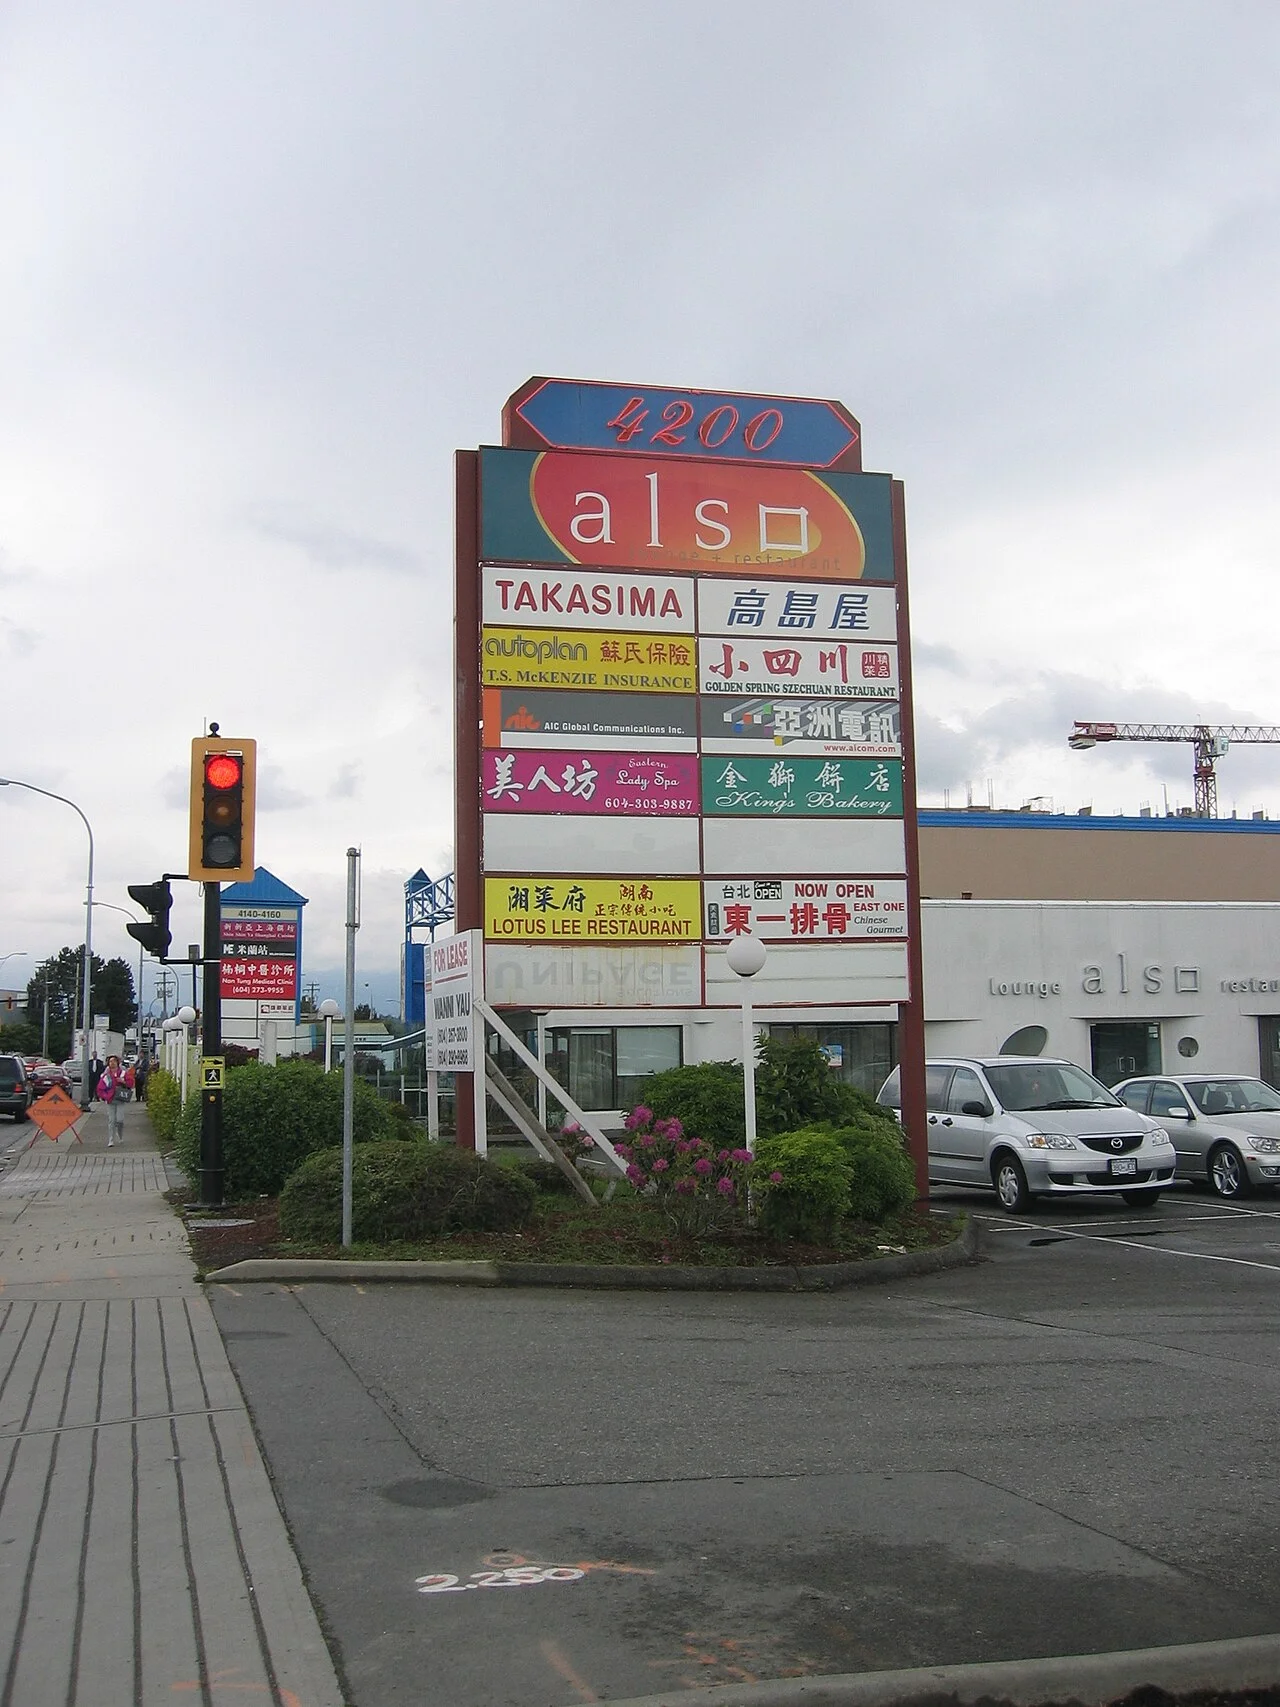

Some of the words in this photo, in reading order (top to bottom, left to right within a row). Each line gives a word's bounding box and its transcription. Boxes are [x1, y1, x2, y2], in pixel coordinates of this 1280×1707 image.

[607, 398, 784, 451] 4200
[495, 580, 683, 619] TAKASIMA
[726, 588, 871, 631] 高島屋
[485, 635, 589, 665] autoplan
[600, 640, 692, 667] 蘇氏保險
[708, 643, 849, 684] 小四川
[486, 669, 512, 682] T.S.
[516, 671, 598, 685] McKENZIE
[604, 674, 693, 689] INSURANCE
[705, 682, 743, 693] GOLDEN
[745, 683, 782, 694] SPRING
[783, 684, 833, 695] SZECHUAN
[834, 686, 897, 698] RESTAURANT
[544, 721, 559, 731] AIC
[562, 722, 590, 732] Global
[593, 723, 666, 735] Communications
[669, 725, 686, 735] Inc.
[823, 744, 897, 754] www.aicom.com
[628, 757, 668, 769] Eastern
[487, 754, 599, 802] 美人坊
[616, 770, 650, 791] Lady
[654, 771, 680, 791] Spa
[605, 797, 693, 811] 604-303-9887
[716, 790, 796, 813] King's
[806, 792, 892, 814] Bakery
[508, 885, 587, 913] 湘菜府
[722, 883, 751, 900] 台北
[755, 888, 782, 900] OPEN
[795, 883, 828, 898] NOW
[836, 884, 875, 899] OPEN
[853, 902, 880, 912] EAST
[883, 903, 906, 912] ONE
[493, 918, 547, 935] LOTUS
[552, 919, 582, 935] LEE
[587, 920, 693, 936] RESTAURANT
[723, 903, 852, 937] 東一排骨
[854, 916, 889, 926] Chinese
[867, 924, 904, 935] Gourmet
[434, 948, 446, 974] FOR
[447, 940, 469, 971] LEASE
[233, 986, 250, 994] (604)
[990, 978, 1062, 999] lounge
